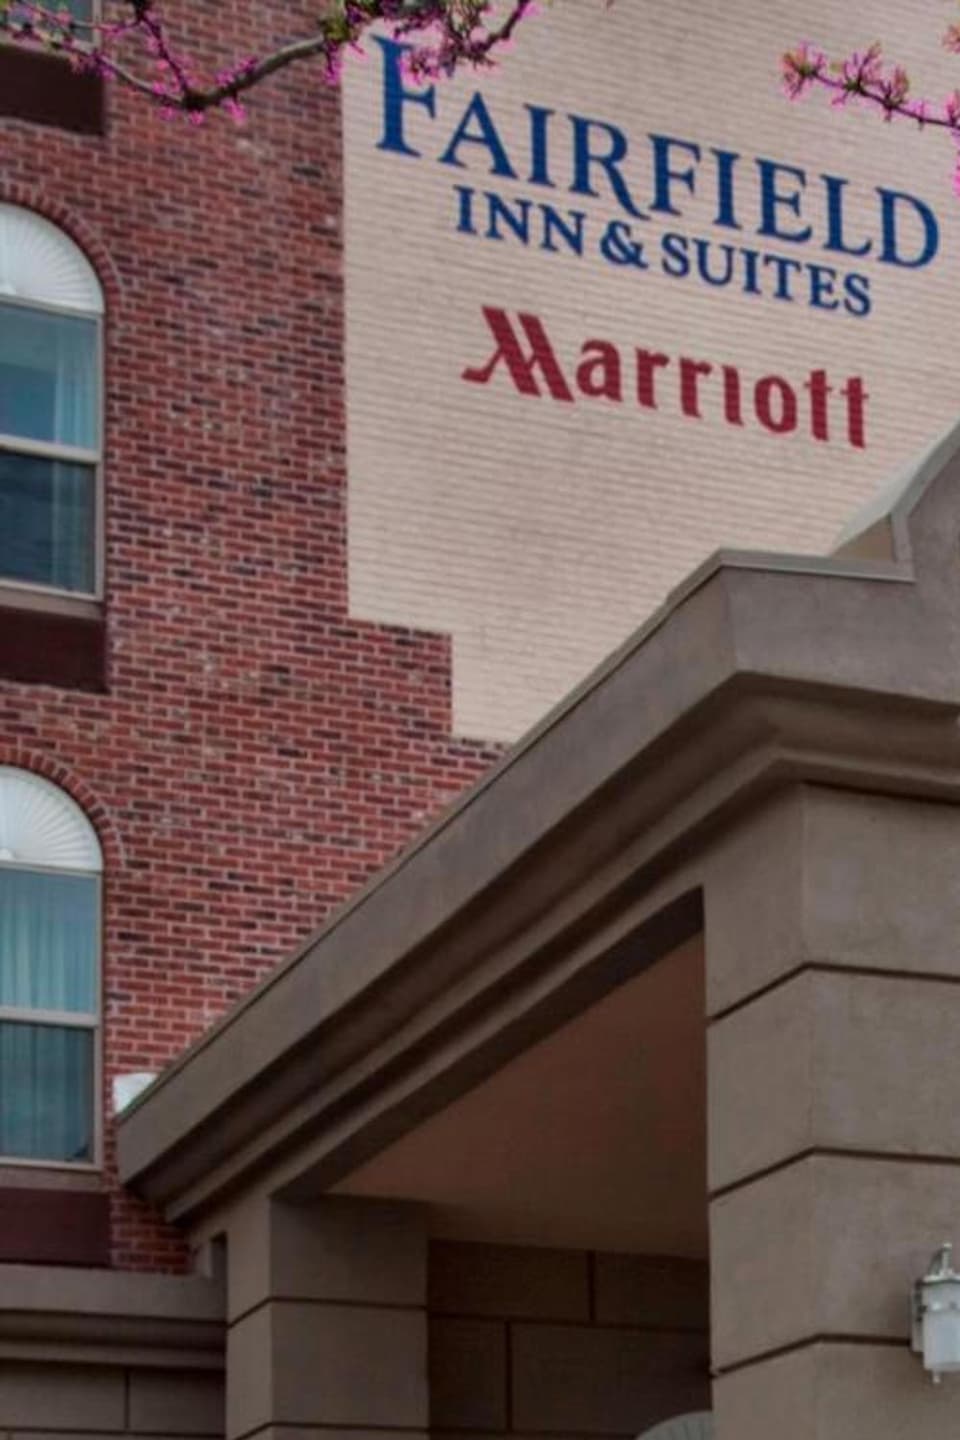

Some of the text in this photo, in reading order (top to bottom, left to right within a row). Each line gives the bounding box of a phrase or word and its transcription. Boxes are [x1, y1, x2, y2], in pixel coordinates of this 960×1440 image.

[372, 34, 940, 269] FAIRFIELD
[453, 186, 872, 317] INN & SUITES
[461, 306, 869, 449] Marriott
